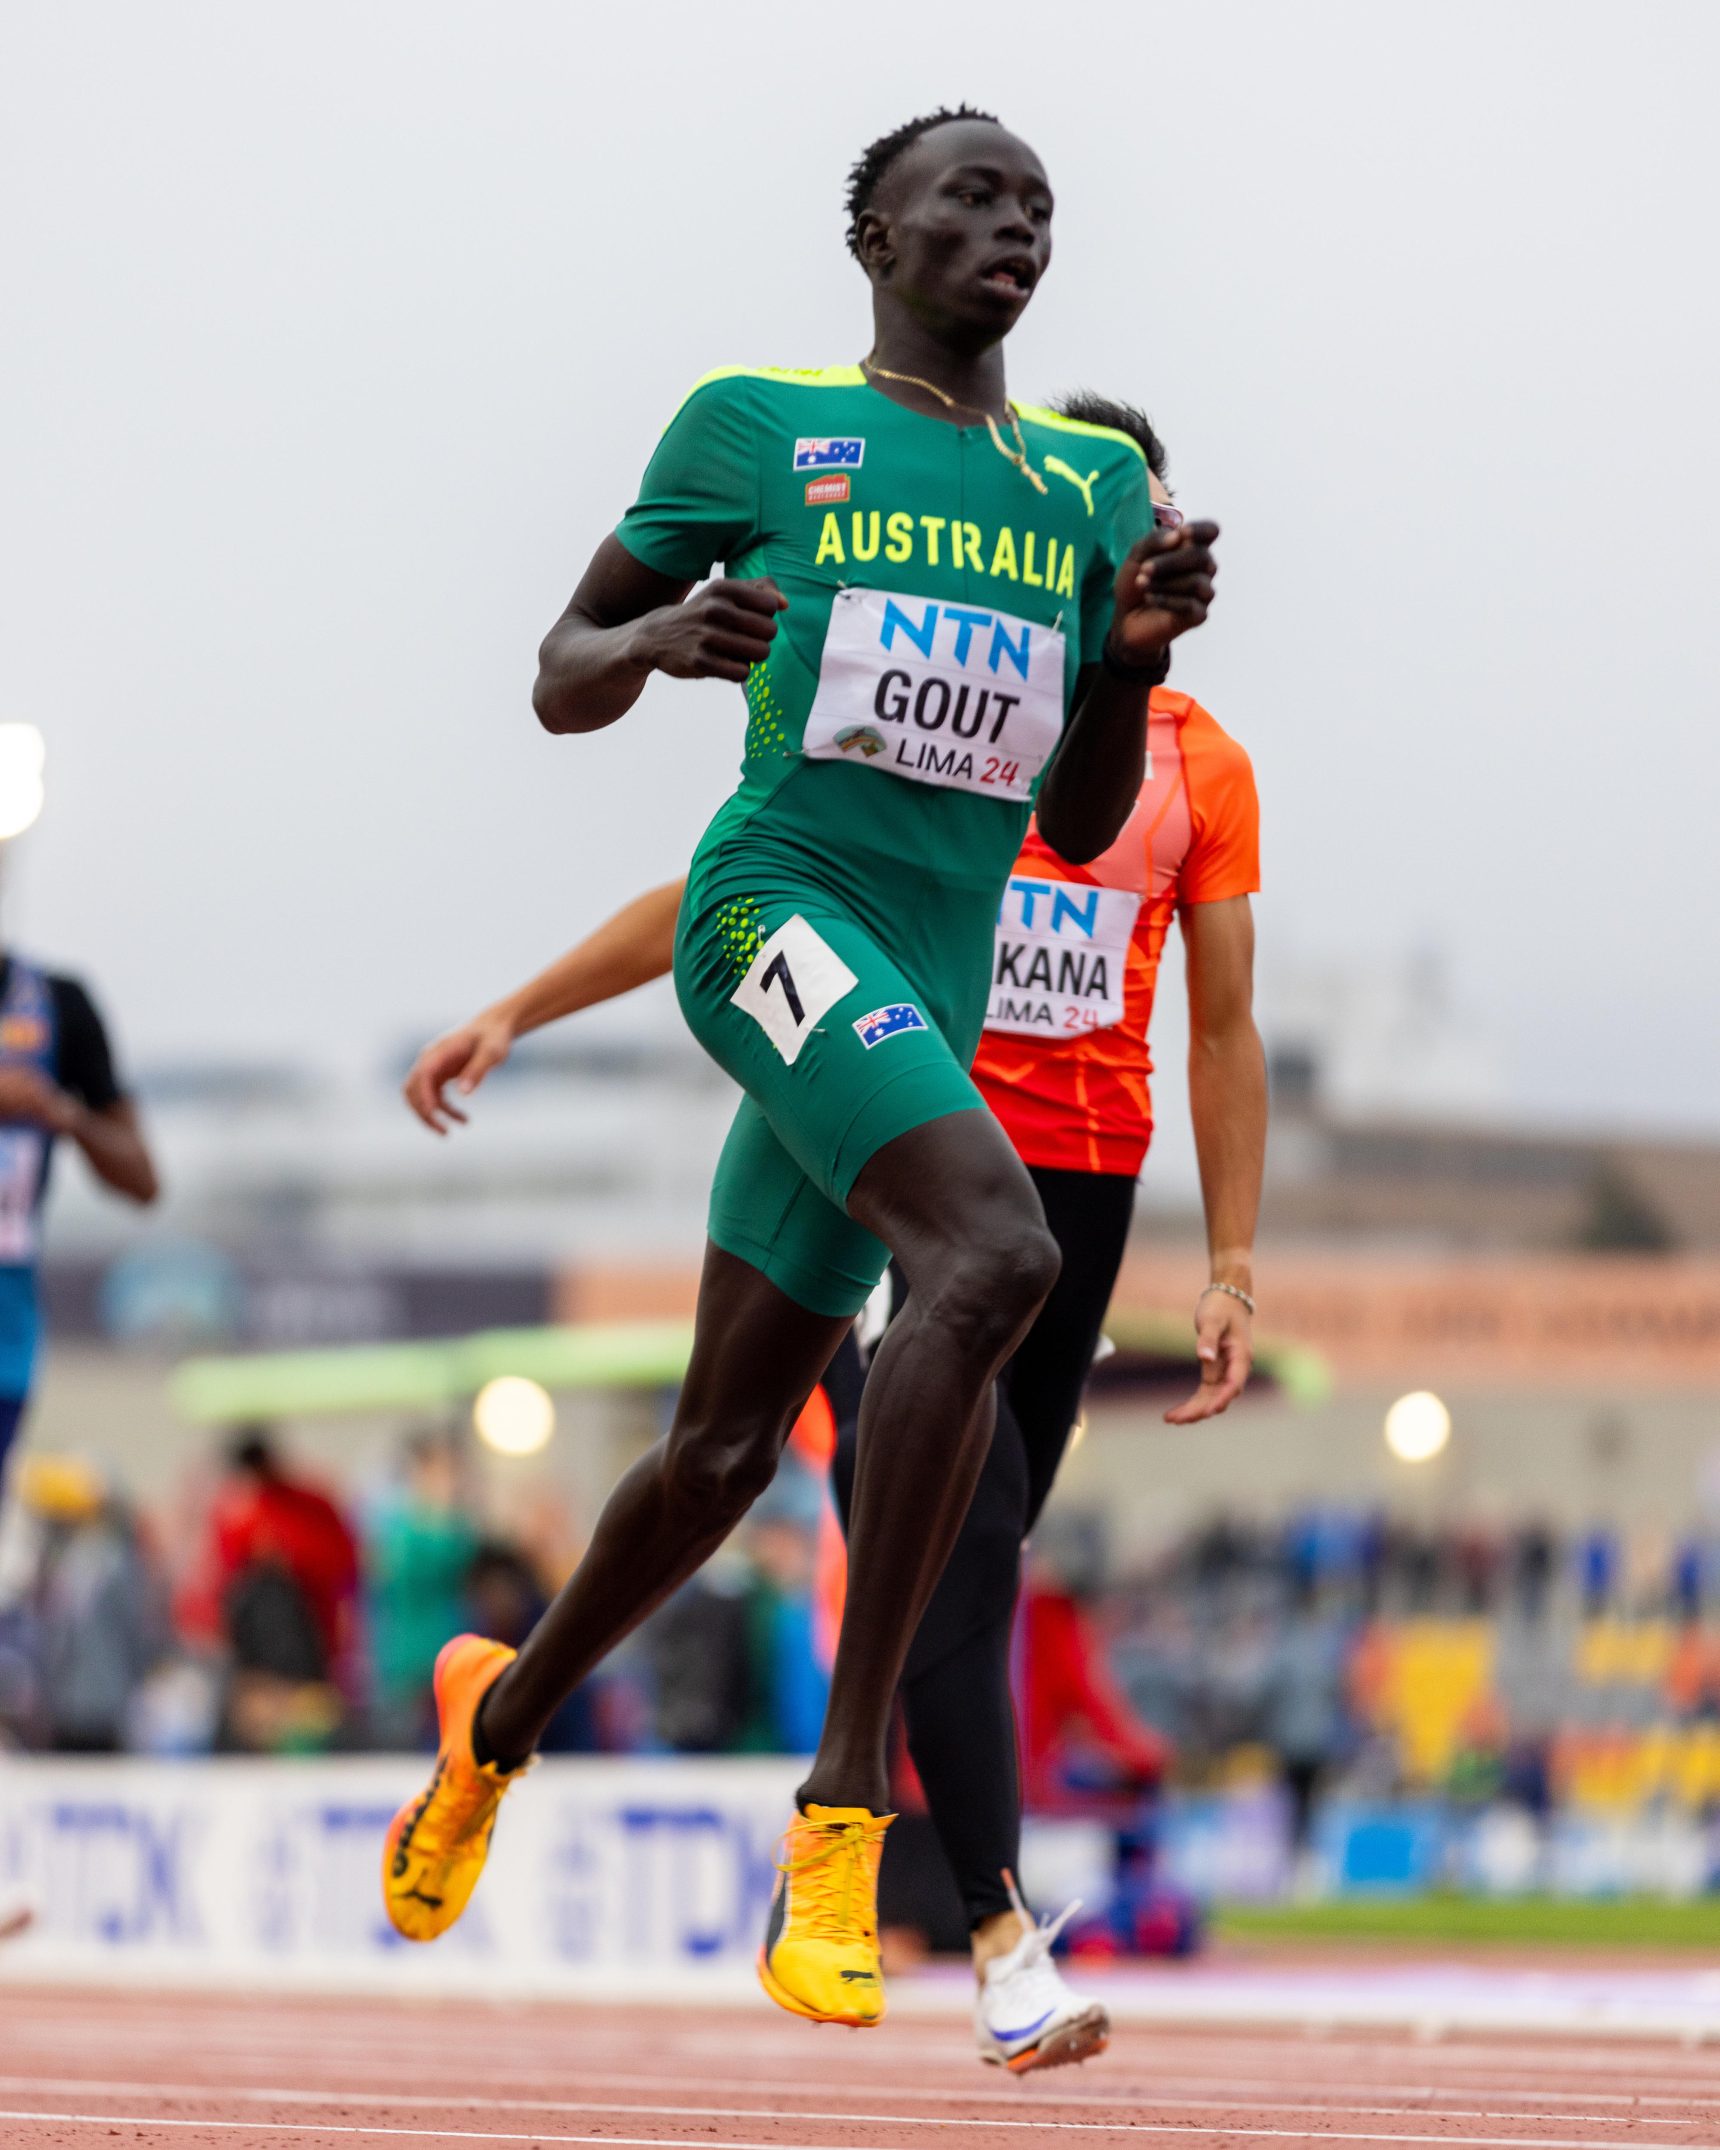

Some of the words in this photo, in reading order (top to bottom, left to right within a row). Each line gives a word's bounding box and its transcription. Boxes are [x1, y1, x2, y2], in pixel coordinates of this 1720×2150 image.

[808, 482, 847, 495] CHEMIST
[815, 510, 1075, 599] AUSTRALIA
[879, 597, 1031, 682] NTN
[873, 668, 1021, 744] GOUT
[895, 738, 974, 780] LIMA
[979, 756, 1020, 787] 24
[996, 880, 1099, 939] TN
[759, 950, 806, 1028] 7
[985, 998, 1054, 1026] IMA
[1063, 1005, 1099, 1030] 24
